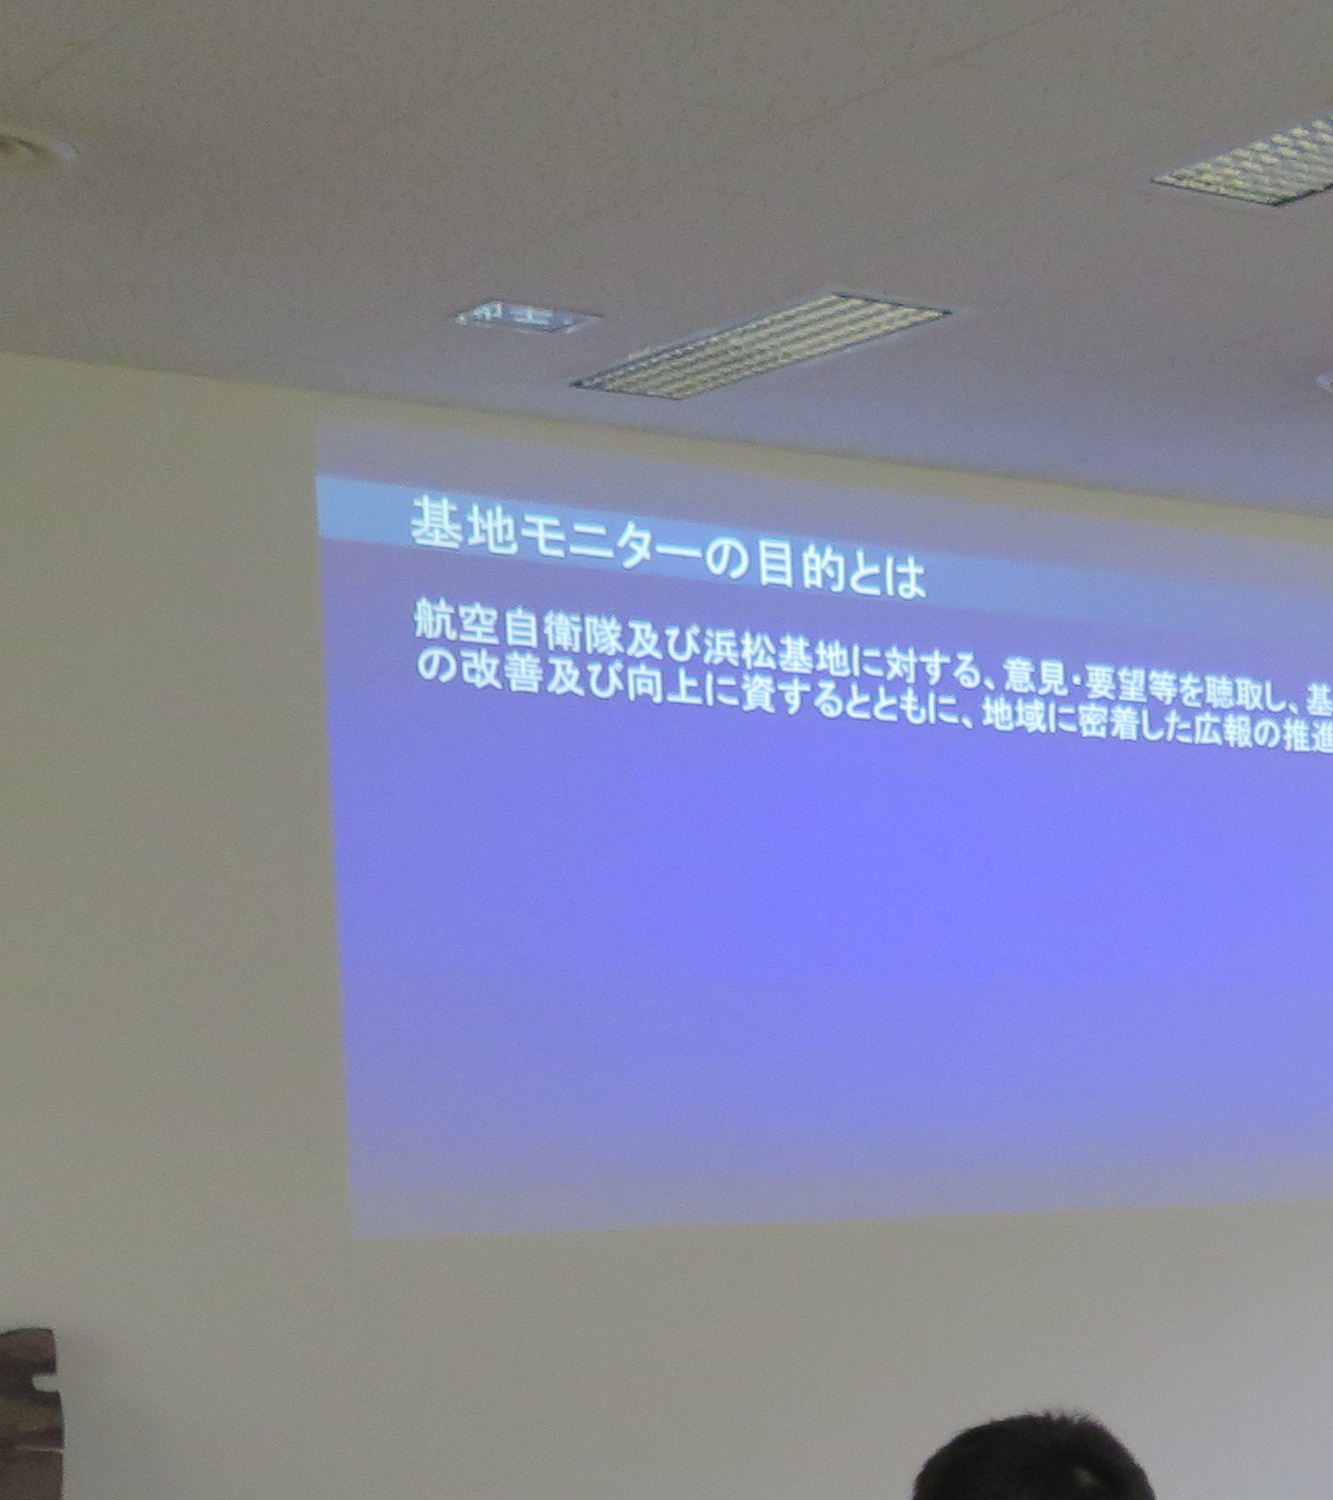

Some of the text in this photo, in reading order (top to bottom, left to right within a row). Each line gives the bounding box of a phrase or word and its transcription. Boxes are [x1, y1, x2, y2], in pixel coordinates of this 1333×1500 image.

[410, 493, 927, 600] 基地モニターの目的とは
